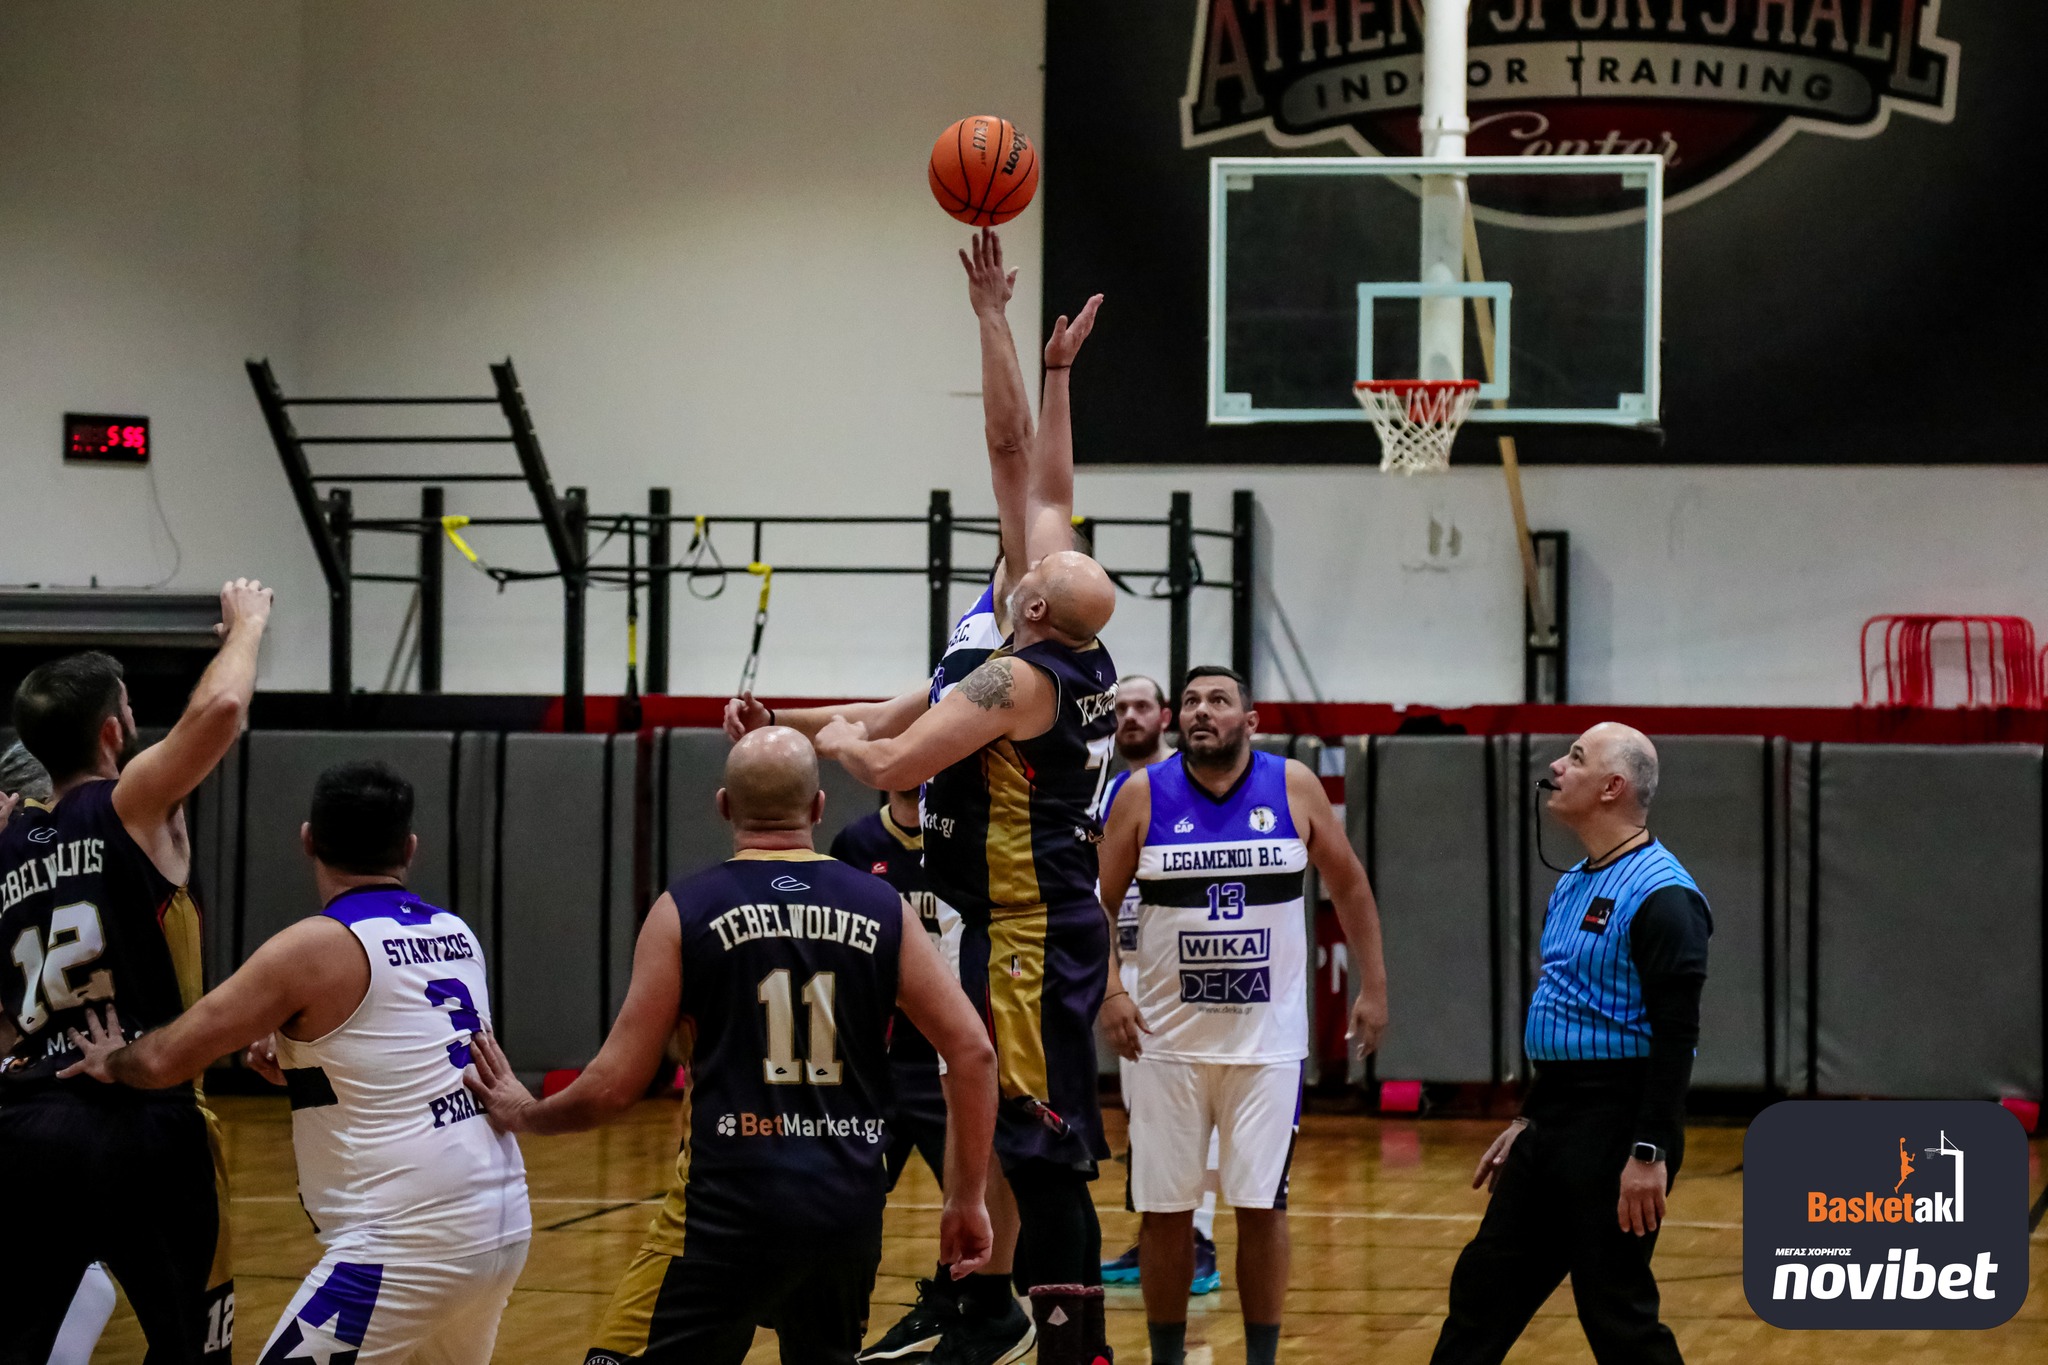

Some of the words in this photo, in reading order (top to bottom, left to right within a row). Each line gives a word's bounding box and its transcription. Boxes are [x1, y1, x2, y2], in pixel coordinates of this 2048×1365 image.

[1315, 58, 1528, 109] INDOR
[1566, 56, 1833, 101] TRAINING
[1173, 822, 1195, 834] CAP
[1162, 847, 1254, 872] LEGAMENOI
[1258, 846, 1287, 867] B.C.
[1206, 881, 1246, 921] 13
[708, 903, 881, 955] TEBELWOLVES
[1184, 936, 1259, 957] WIKA
[10, 900, 116, 1036] 12
[1181, 971, 1269, 1000] DEKA
[424, 977, 482, 1069] 3
[757, 968, 844, 1085] 11
[740, 1112, 886, 1144] BetMarket.gr
[203, 1291, 235, 1355] 12
